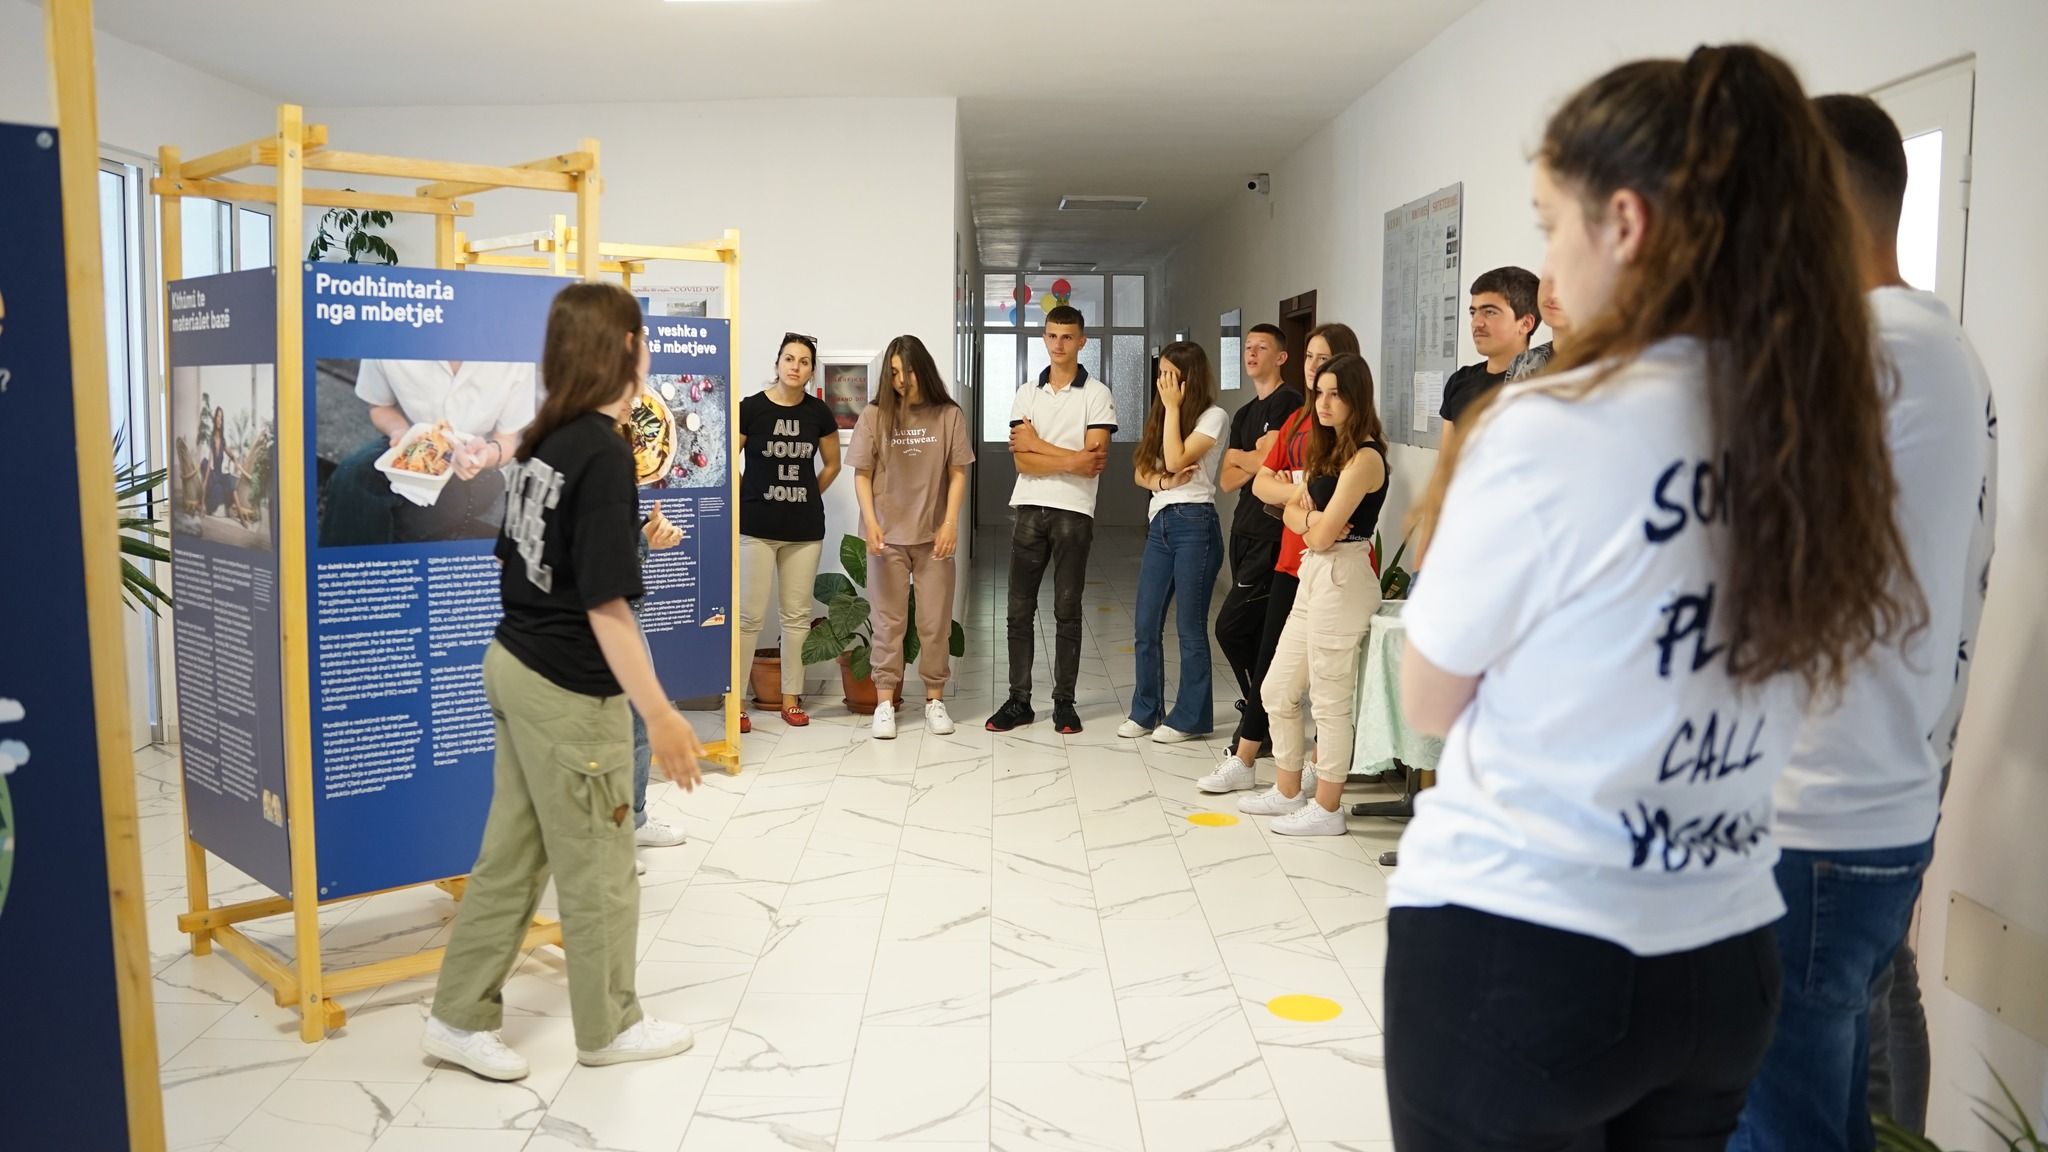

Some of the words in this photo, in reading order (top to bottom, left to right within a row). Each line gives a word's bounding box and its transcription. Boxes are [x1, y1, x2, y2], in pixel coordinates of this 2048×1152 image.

[316, 273, 454, 301] Prodhimtaria
[171, 288, 197, 310] Kthimi
[197, 292, 205, 307] te
[172, 310, 210, 332] materialet
[210, 308, 230, 328] bazë
[316, 303, 356, 325] nga
[361, 301, 444, 328] mbetjet
[657, 324, 697, 338] veshka
[700, 328, 708, 338] e
[648, 339, 661, 353] të
[663, 340, 717, 357] mbetjeve
[772, 418, 800, 437] AU
[894, 428, 927, 437] Luxury
[761, 440, 814, 459] JOUR
[890, 436, 938, 447] portswear.
[777, 464, 800, 481] LE
[763, 485, 808, 503] JOUR
[1657, 709, 1766, 785] CALL
